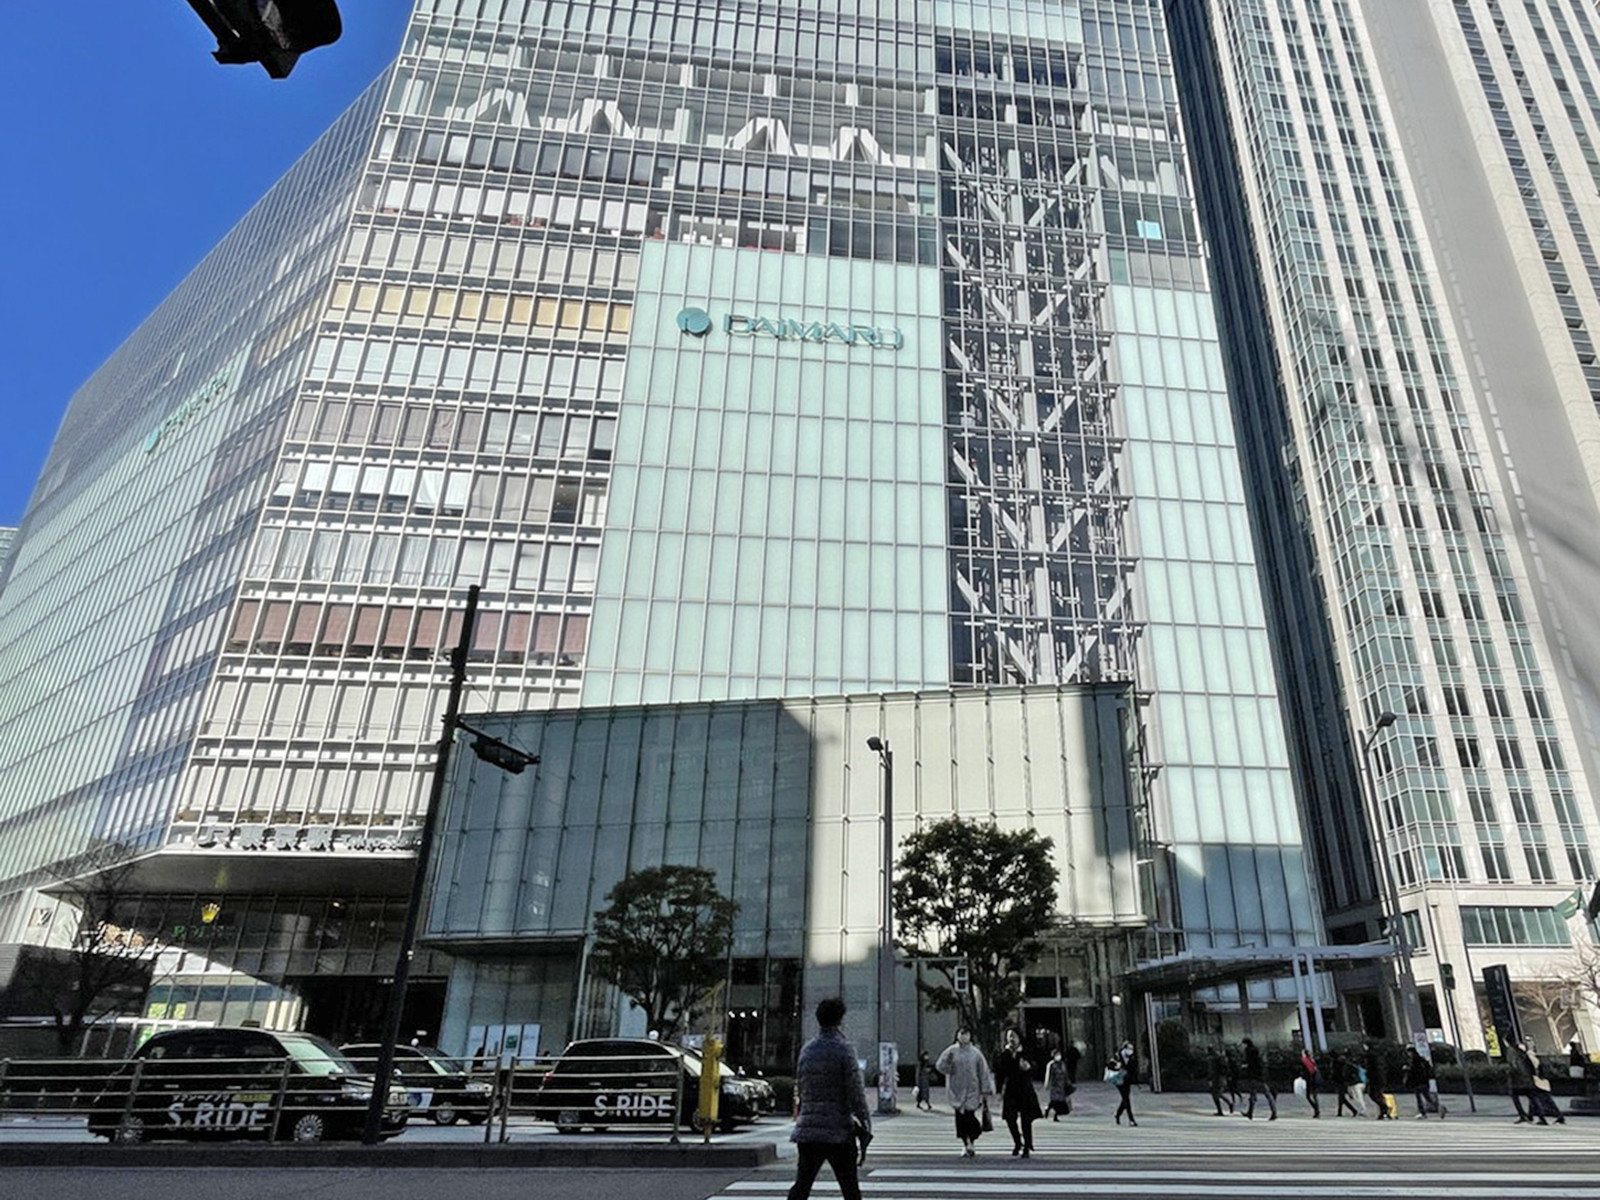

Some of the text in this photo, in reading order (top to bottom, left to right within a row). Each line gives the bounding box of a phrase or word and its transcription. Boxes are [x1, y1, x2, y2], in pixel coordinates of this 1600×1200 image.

[724, 313, 904, 351] DAIMARU
[340, 834, 381, 850] Tokyo
[167, 1102, 270, 1131] S.RIDE
[593, 1094, 672, 1117] S.RIDE
